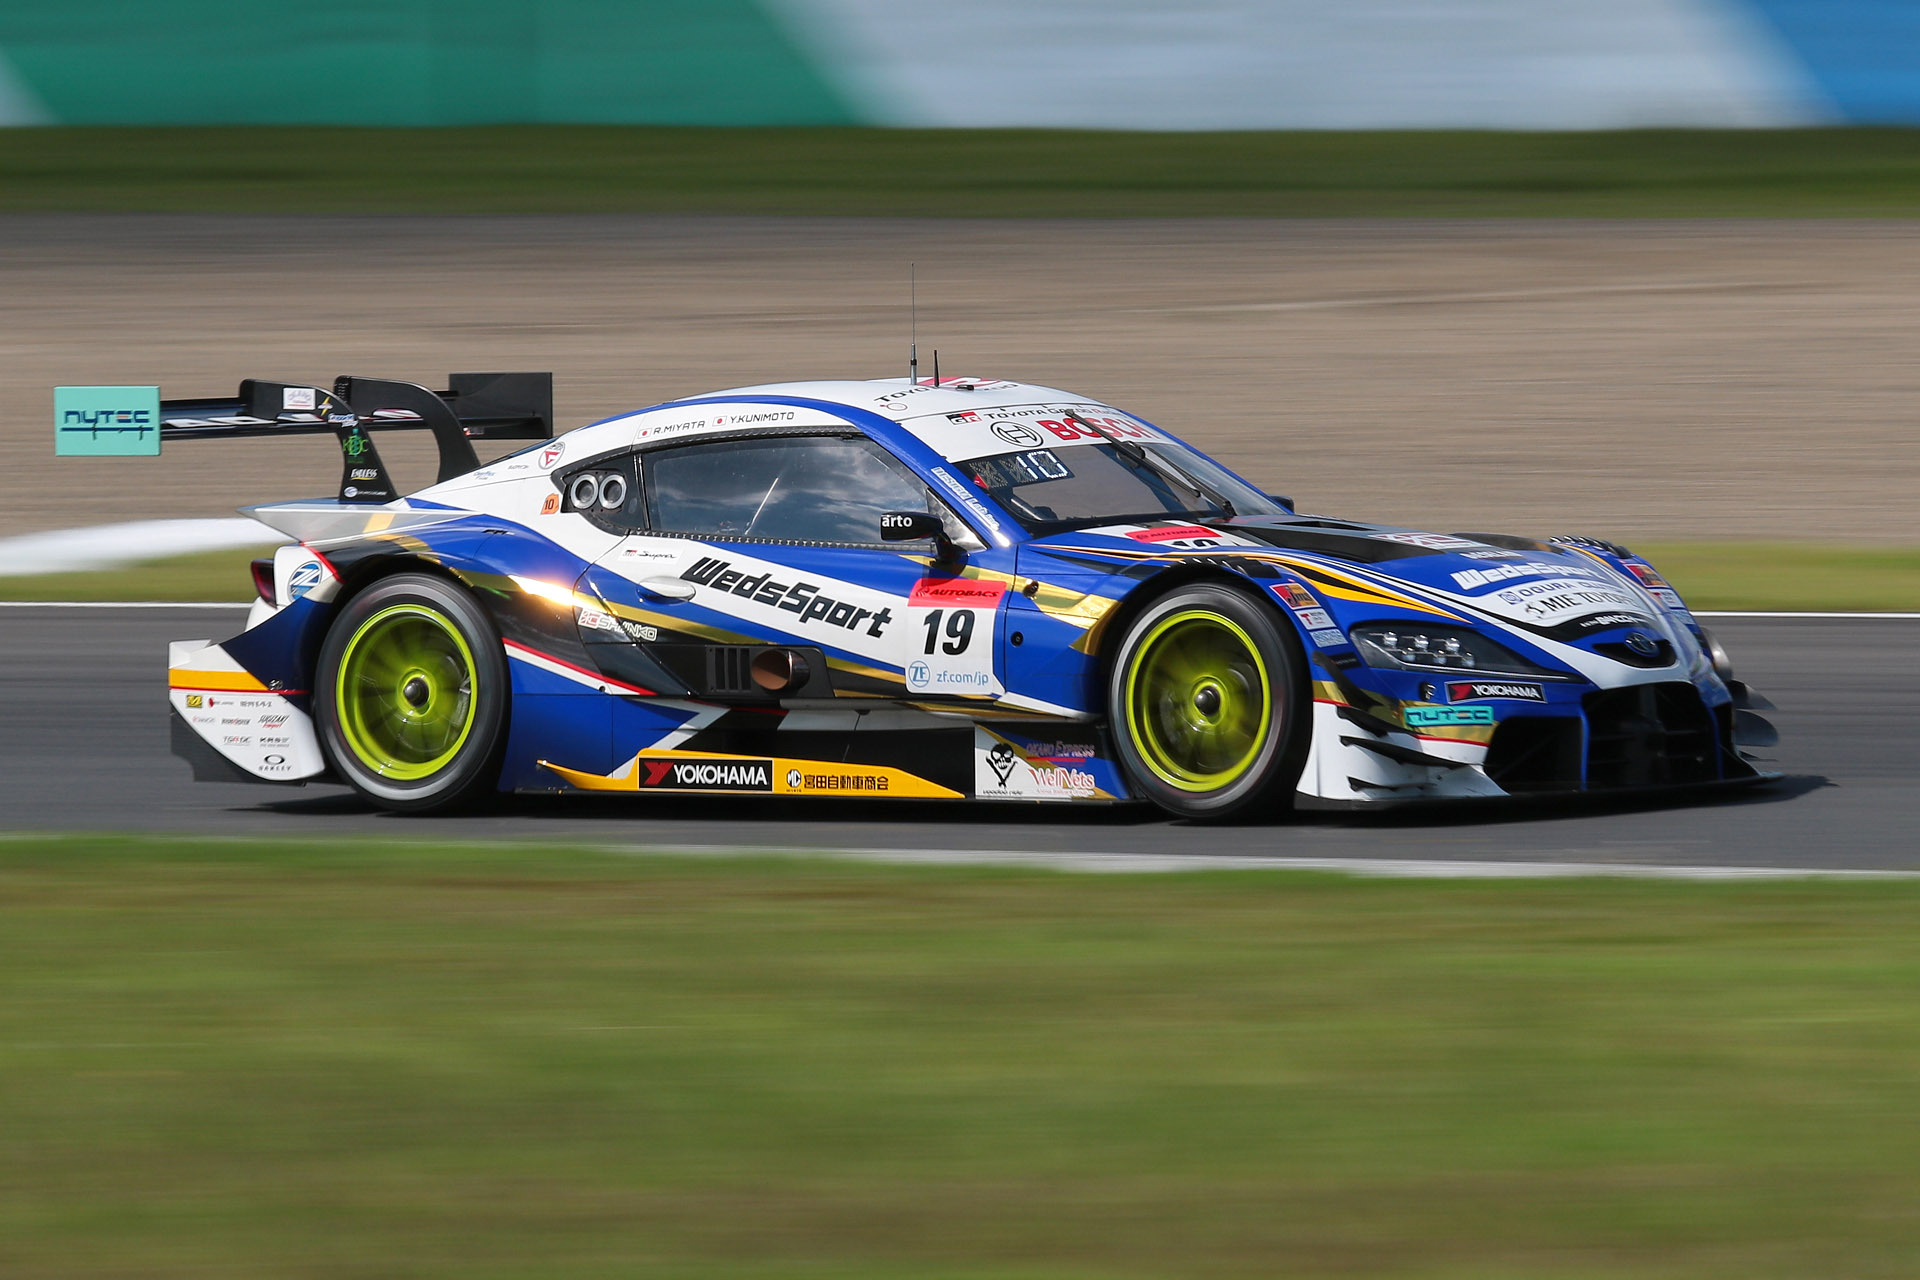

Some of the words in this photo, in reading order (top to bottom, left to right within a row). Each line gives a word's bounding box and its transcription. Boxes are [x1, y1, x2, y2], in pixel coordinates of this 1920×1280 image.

[730, 411, 795, 424] Y.KUNIMOTO
[983, 409, 1046, 420] TOYOTA
[653, 420, 706, 435] R.MIYATA
[1036, 417, 1161, 441] BOSCH
[544, 498, 555, 510] 10
[882, 515, 913, 527] arto
[930, 589, 999, 598] AUTOBACS
[1523, 580, 1575, 597] OGURA
[679, 556, 892, 638] WedsSport
[1541, 592, 1582, 612] MIE
[923, 609, 976, 656] 19
[936, 671, 989, 685] zf.com/jp
[1473, 685, 1540, 698] YOKOHAMA
[673, 765, 768, 785] YOKOHAMA
[1028, 768, 1095, 790] WellNets
